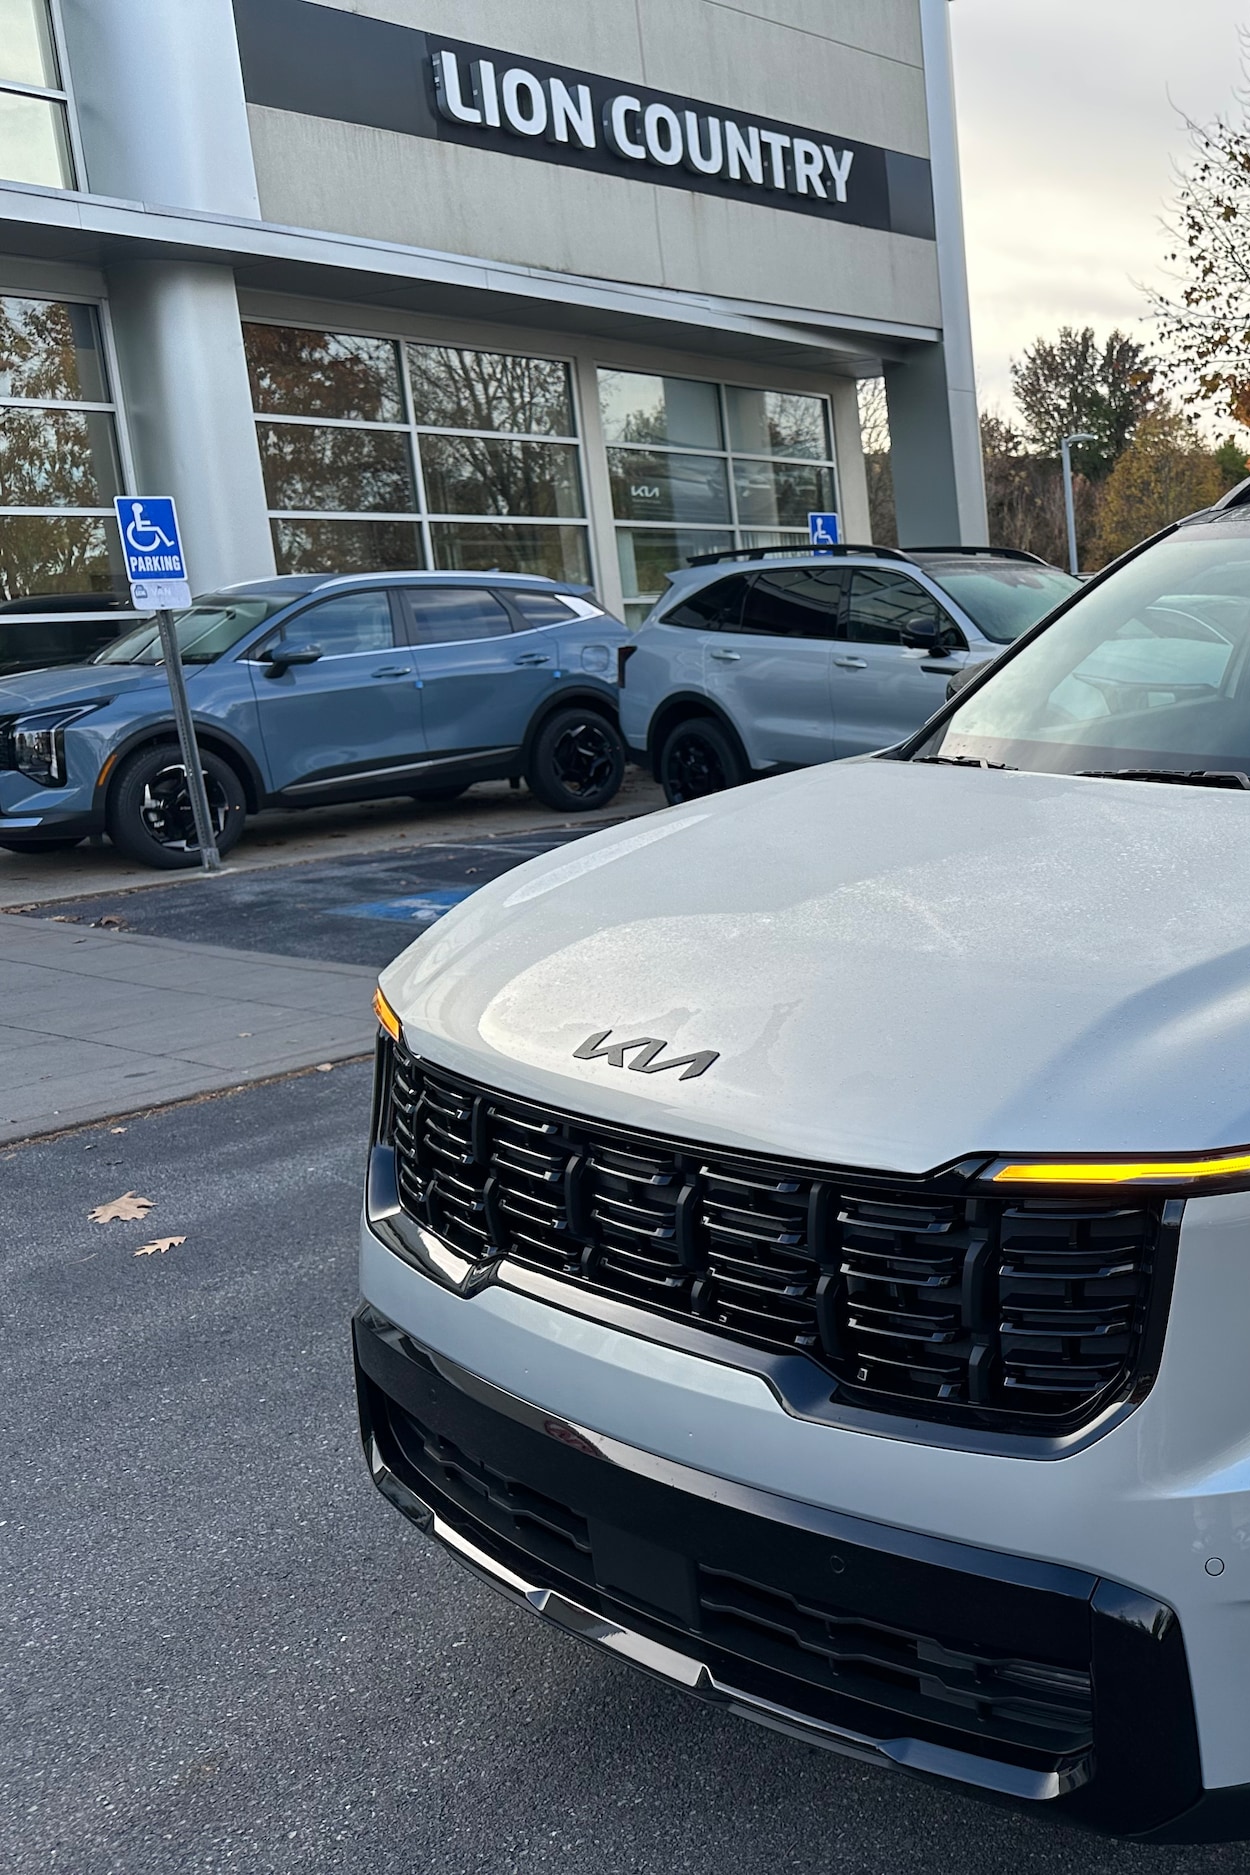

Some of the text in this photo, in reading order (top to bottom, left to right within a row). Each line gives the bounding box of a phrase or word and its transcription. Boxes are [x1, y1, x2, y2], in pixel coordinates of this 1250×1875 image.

[431, 50, 854, 203] LION COUNTRY
[130, 555, 181, 571] PARKING
[572, 1029, 720, 1081] KIA
